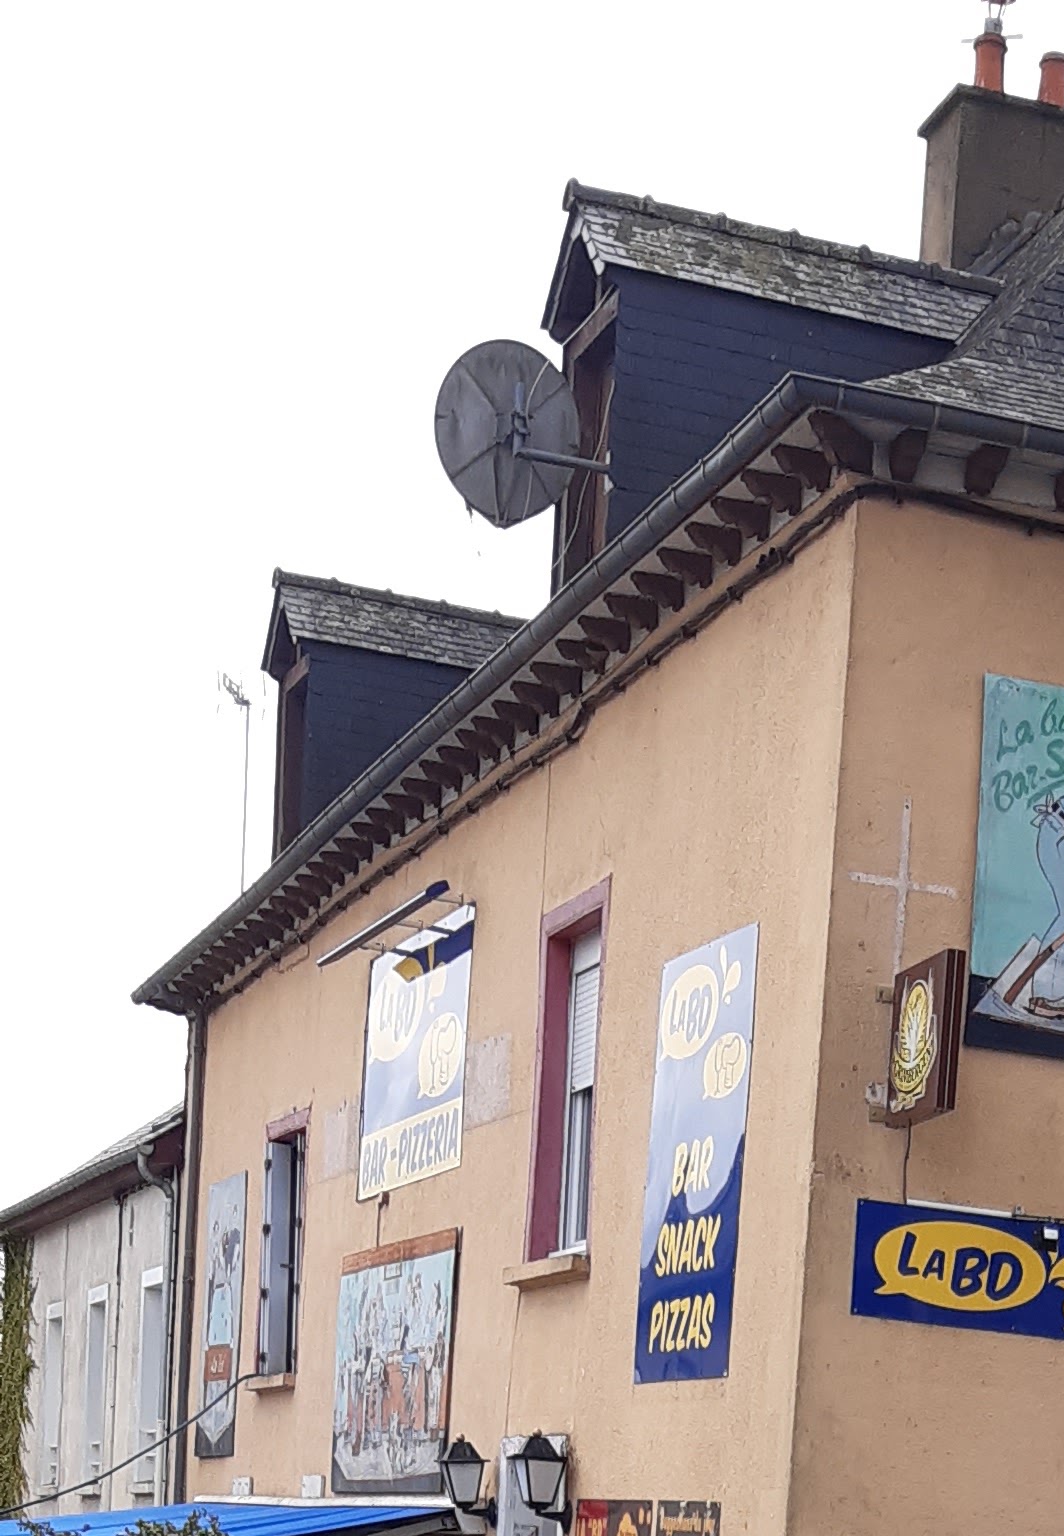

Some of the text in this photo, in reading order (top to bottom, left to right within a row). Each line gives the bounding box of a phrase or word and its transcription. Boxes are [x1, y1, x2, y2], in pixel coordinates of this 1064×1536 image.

[362, 1137, 386, 1191] BAR
[397, 1107, 460, 1178] PIZZERIA
[672, 1135, 714, 1198] BAR
[655, 1213, 722, 1278] SNACK
[648, 1291, 715, 1354] PIZZAS
